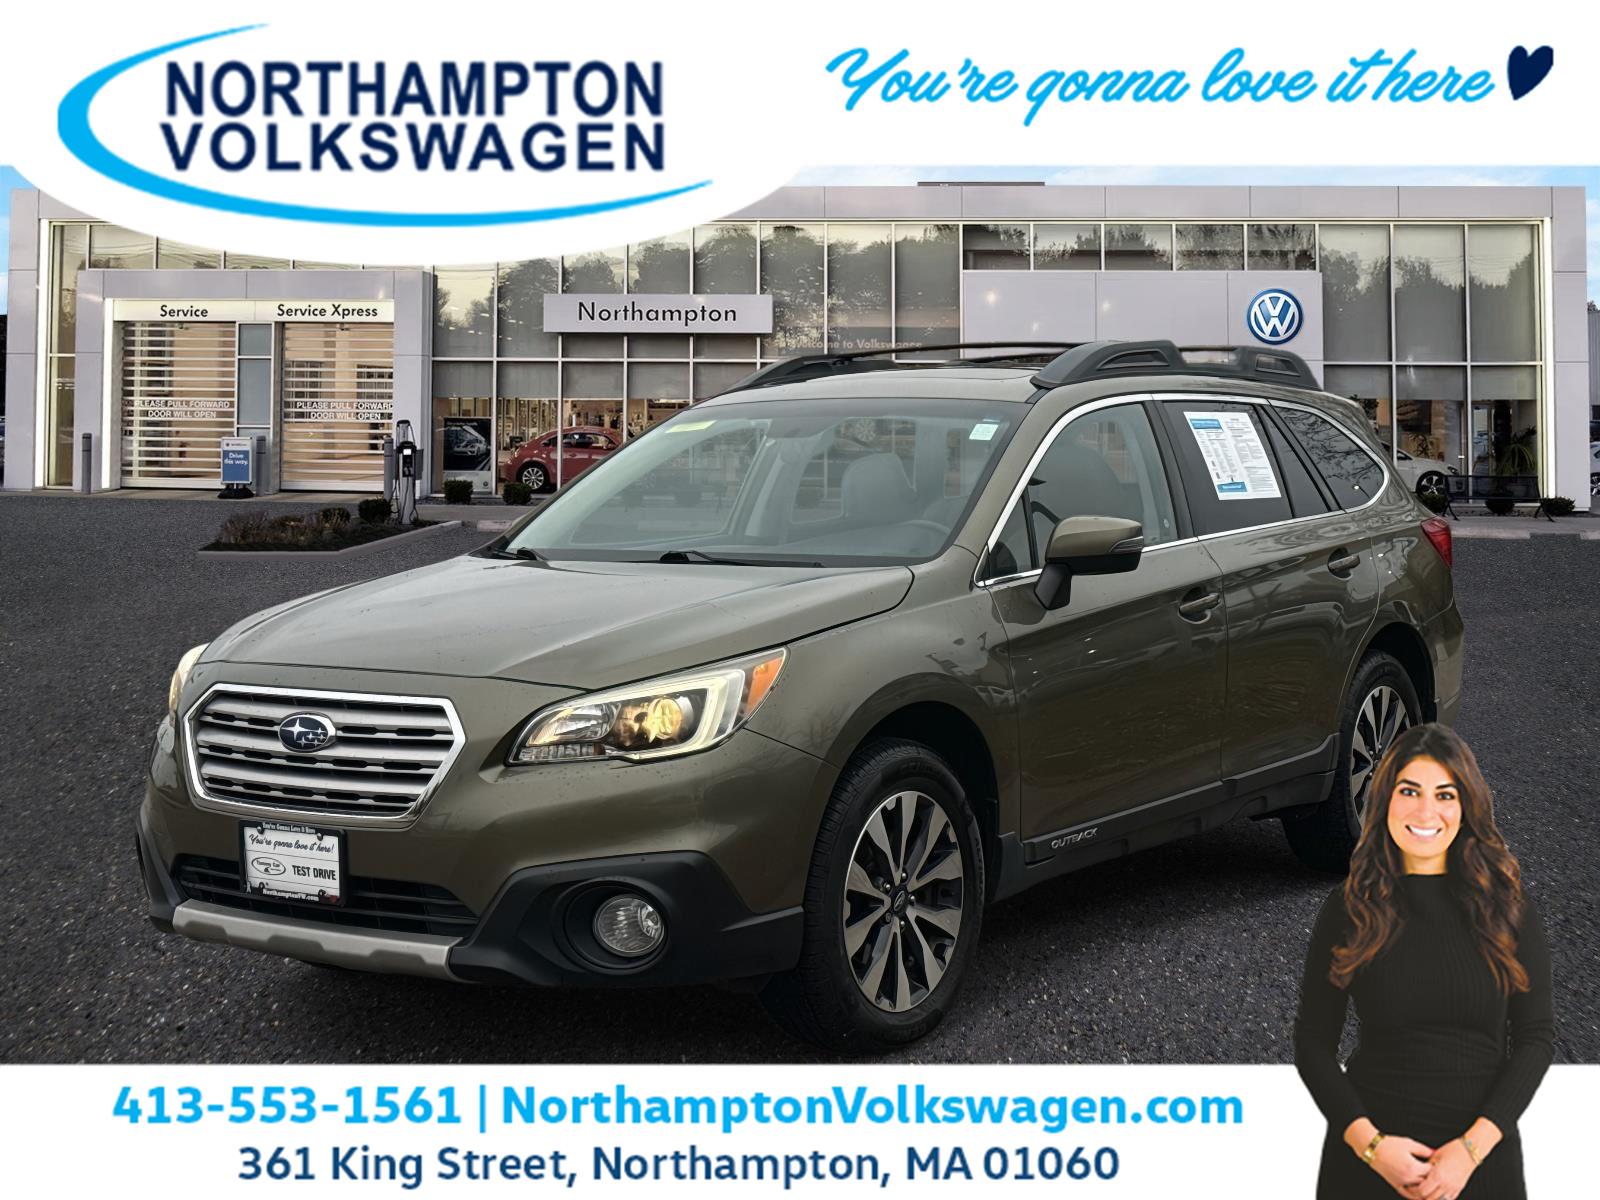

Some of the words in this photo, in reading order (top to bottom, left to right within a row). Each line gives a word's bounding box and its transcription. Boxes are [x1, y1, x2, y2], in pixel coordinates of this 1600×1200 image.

[160, 304, 209, 317] Service
[277, 304, 327, 317] Service
[331, 304, 378, 319] Xpress
[578, 301, 737, 327] Northampton
[843, 340, 854, 349] to
[135, 400, 166, 408] PLEASE
[168, 400, 188, 408] PULL
[190, 400, 230, 408] FORWARD
[296, 401, 328, 409] PLEASE
[330, 402, 352, 410] PULL
[354, 402, 394, 410] FORWARD
[148, 410, 171, 418] DOOR
[173, 410, 192, 418] WILL
[194, 410, 217, 418] OPEN
[357, 412, 381, 420] OPEN
[249, 834, 272, 845] You're
[273, 840, 293, 851] gonna
[294, 840, 308, 851] love
[309, 842, 317, 851] it
[1051, 828, 1098, 849] OUTBACK
[292, 865, 311, 877] TEST
[313, 868, 336, 881] DRIVE
